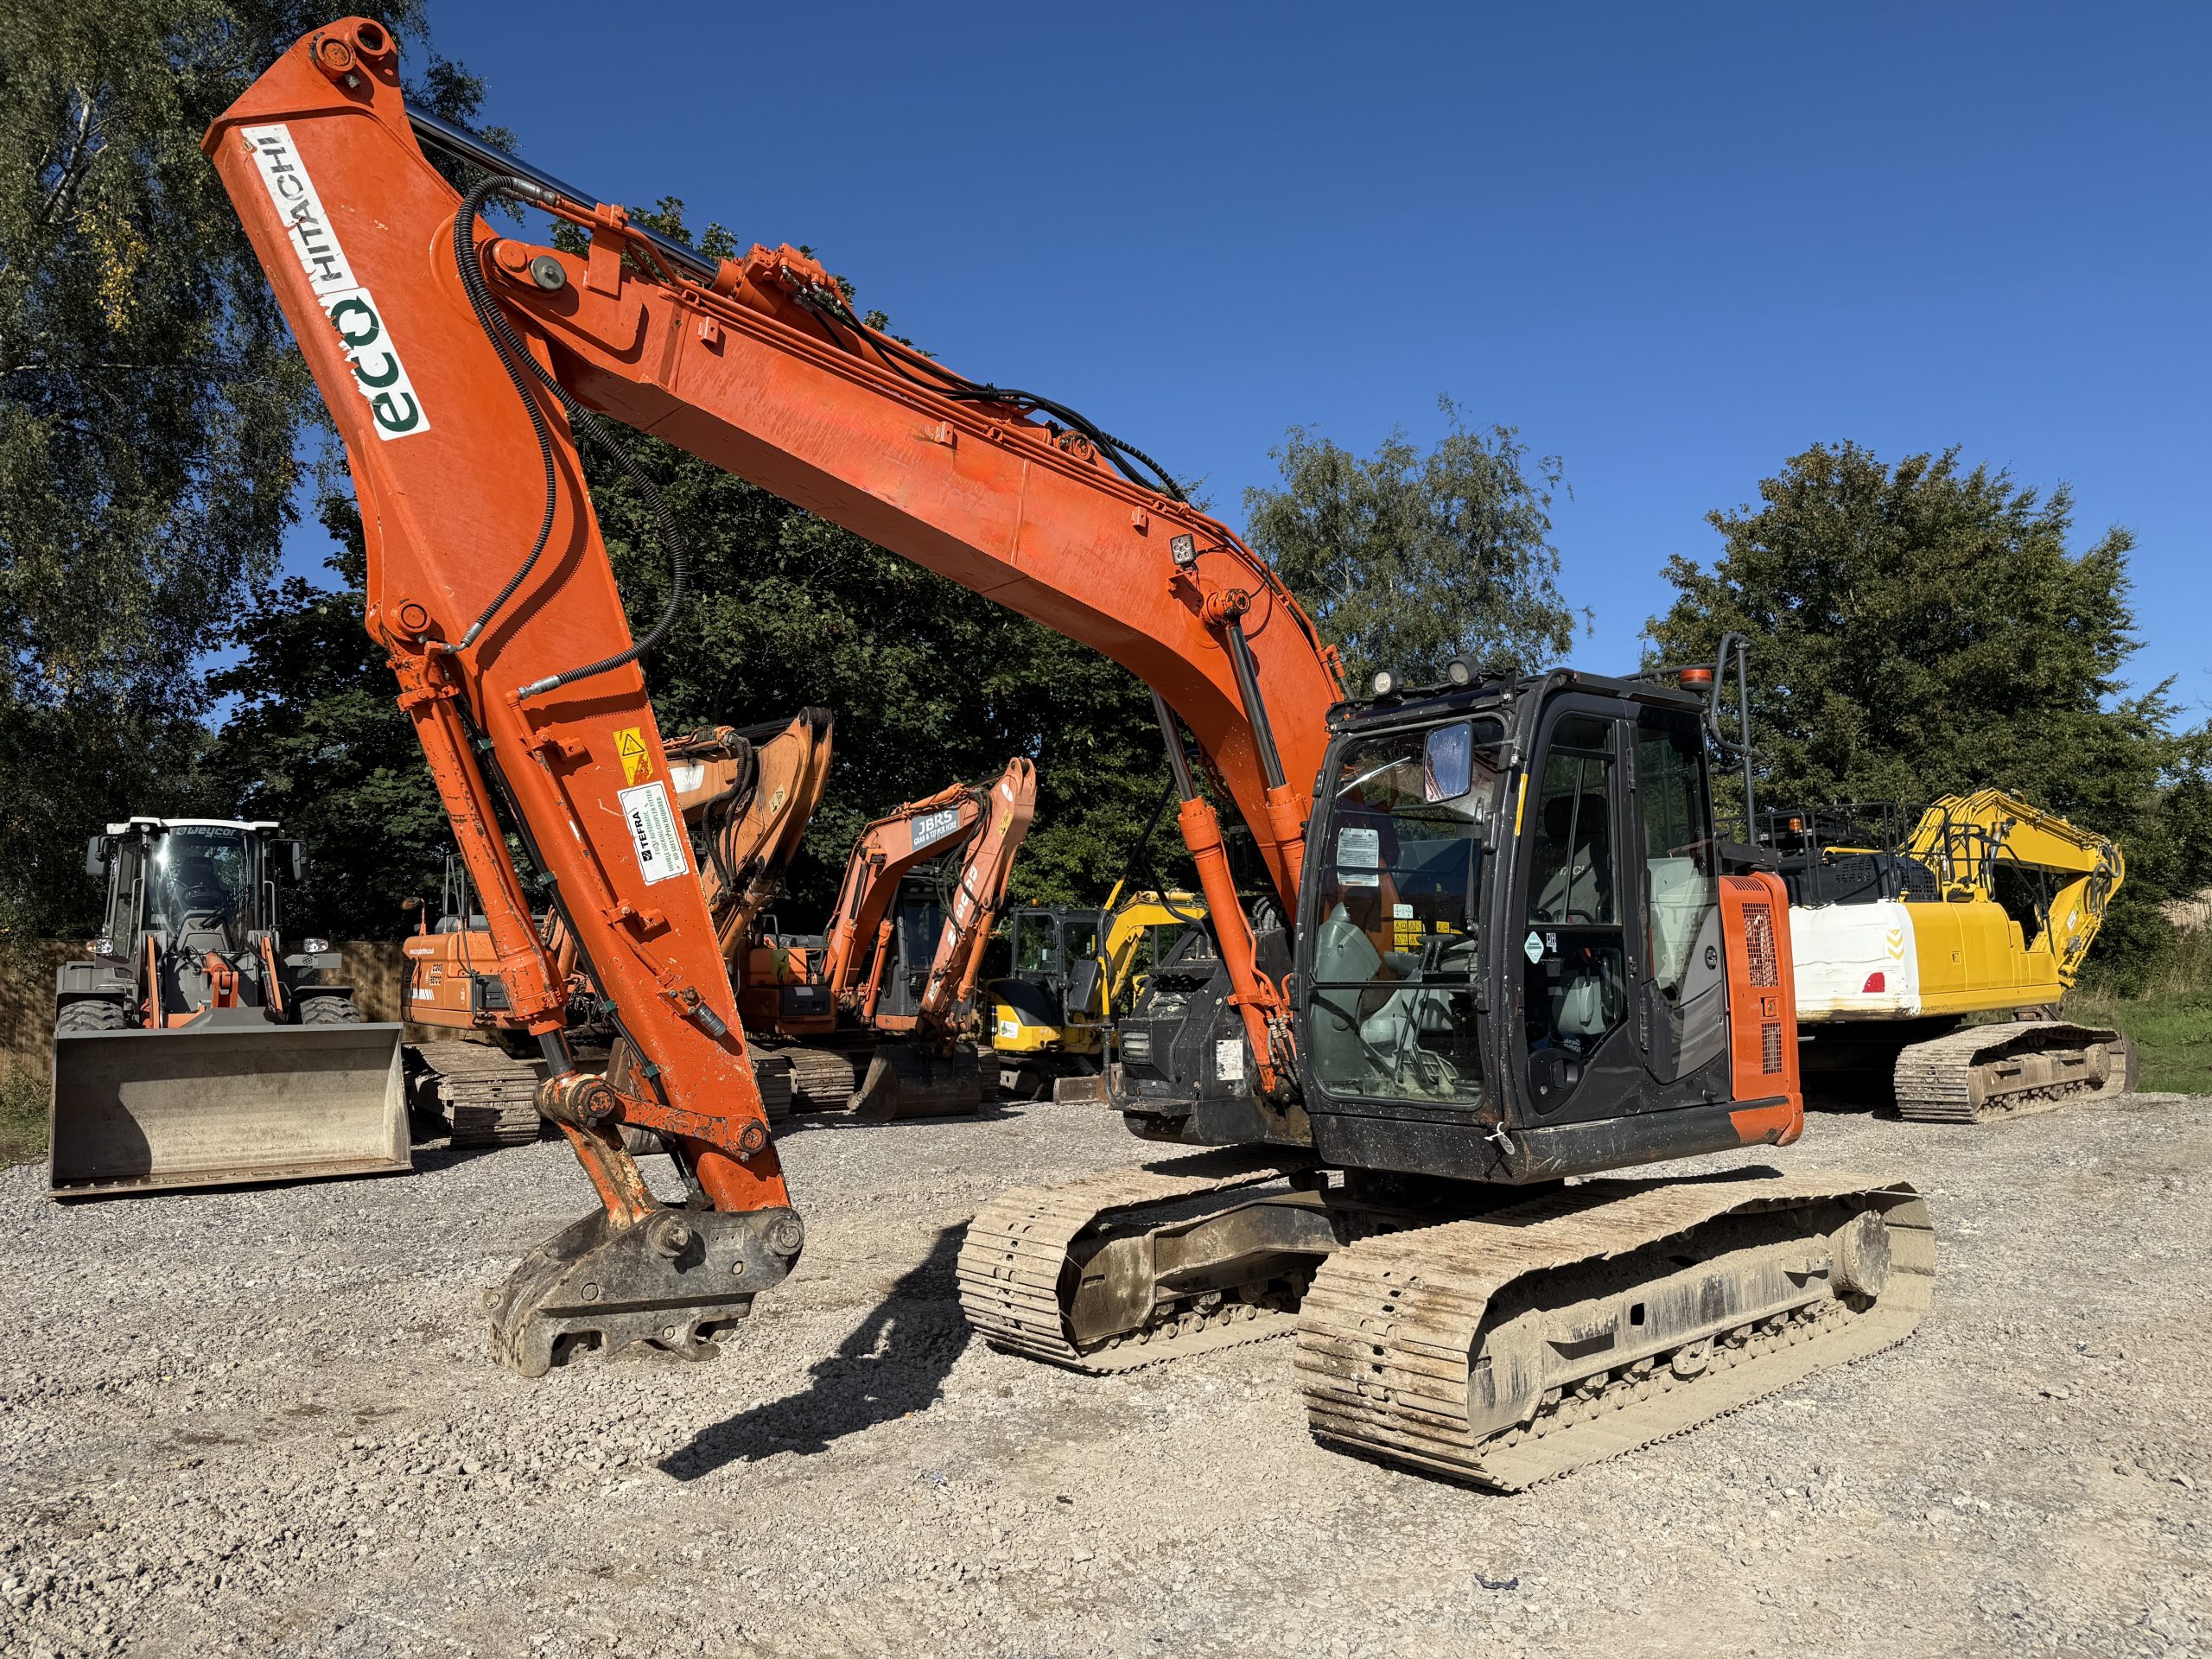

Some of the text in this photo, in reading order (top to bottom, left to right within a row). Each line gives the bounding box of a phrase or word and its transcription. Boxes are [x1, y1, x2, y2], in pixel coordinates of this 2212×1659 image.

[257, 136, 343, 283] HITACHI
[657, 796, 669, 823] REQUIRED
[918, 810, 953, 836] JBRS
[187, 826, 237, 839] weycor
[632, 810, 649, 849] TEFRA
[643, 810, 657, 839] AUTOMATIC
[645, 789, 675, 872] DOUBLE LOCKING COUPLER FITTED
[913, 835, 925, 846] GRAB
[945, 820, 957, 831] HIRE
[667, 835, 677, 853] SAFETY
[673, 852, 680, 861] NO
[947, 864, 978, 947] DOOSN
